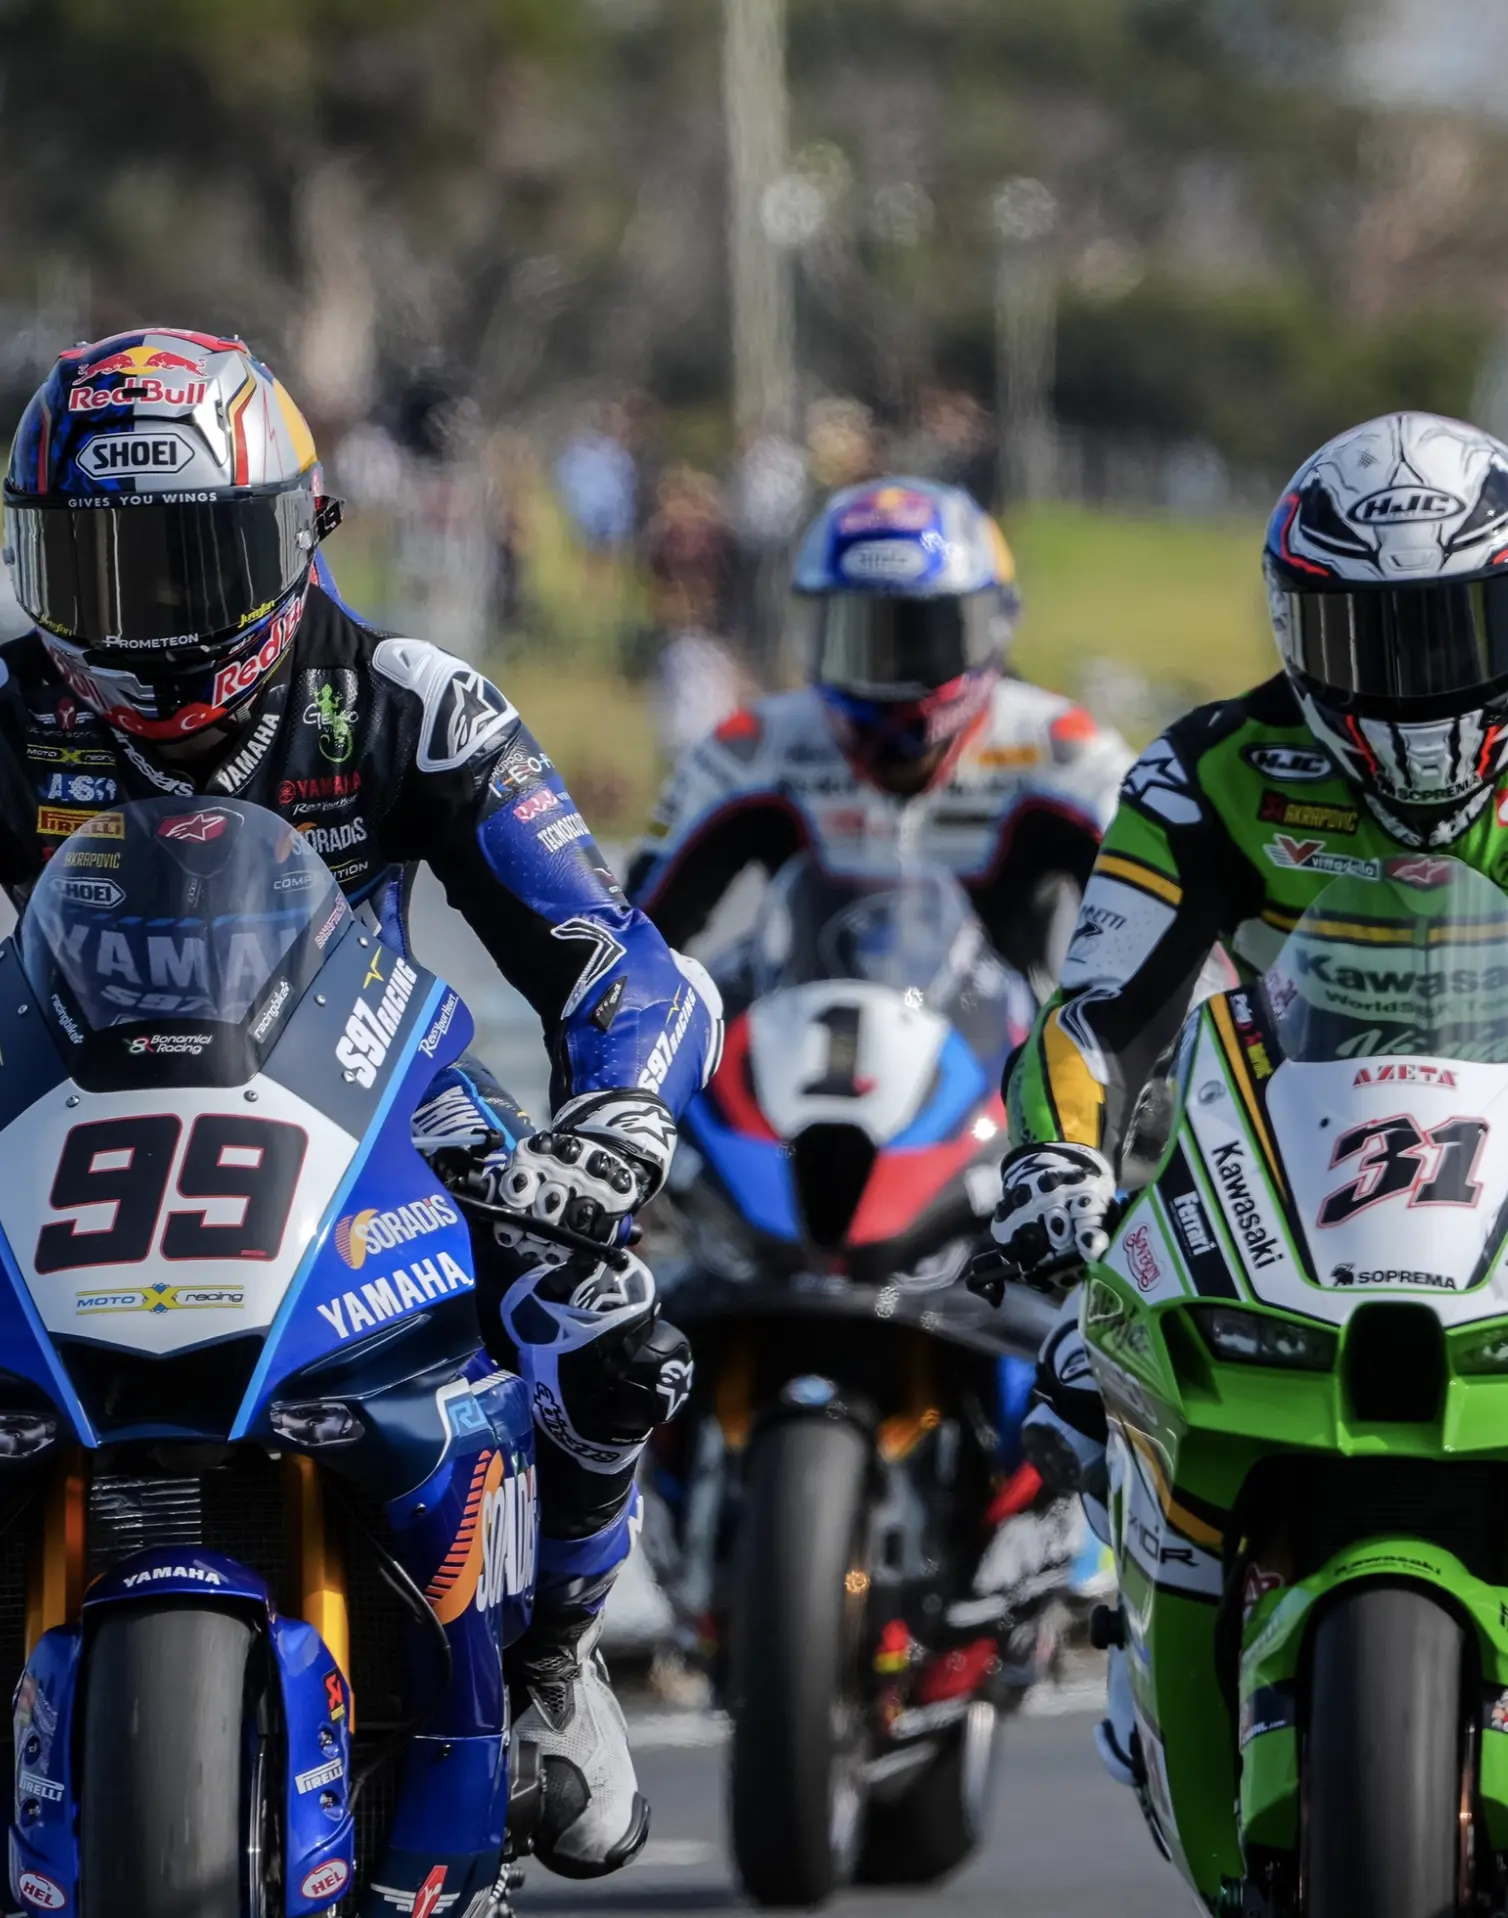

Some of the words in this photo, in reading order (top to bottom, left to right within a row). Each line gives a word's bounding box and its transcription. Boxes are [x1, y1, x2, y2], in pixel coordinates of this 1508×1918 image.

[69, 377, 134, 412] Red
[140, 378, 207, 405] Bull
[93, 440, 177, 470] SHOEI
[68, 497, 110, 508] GIVES
[119, 495, 154, 506] YOU
[162, 492, 218, 504] WINGS
[1362, 494, 1450, 519] HJC
[102, 633, 199, 649] PROMETEON
[217, 713, 281, 794] YAMAHA
[41, 810, 122, 836] PIRELLI
[377, 957, 418, 1037] RACING
[156, 1043, 203, 1055] Racing
[335, 996, 392, 1089] S97
[801, 1004, 863, 1098] 1
[1353, 1064, 1458, 1088] AZETA
[1316, 1113, 1491, 1230] 31
[34, 1112, 309, 1276] 99
[1211, 1140, 1285, 1270] Kawasaki
[1358, 1270, 1457, 1290] SOPREMA
[77, 1296, 136, 1308] MOTO
[184, 1291, 244, 1303] racing
[316, 1252, 471, 1339] YAMAHA
[123, 1566, 222, 1589] YAMAHA
[19, 1770, 65, 1803] PIRELLI
[294, 1757, 345, 1796] PIRELLI
[23, 1881, 55, 1908] HEL
[311, 1871, 345, 1896] HEL
